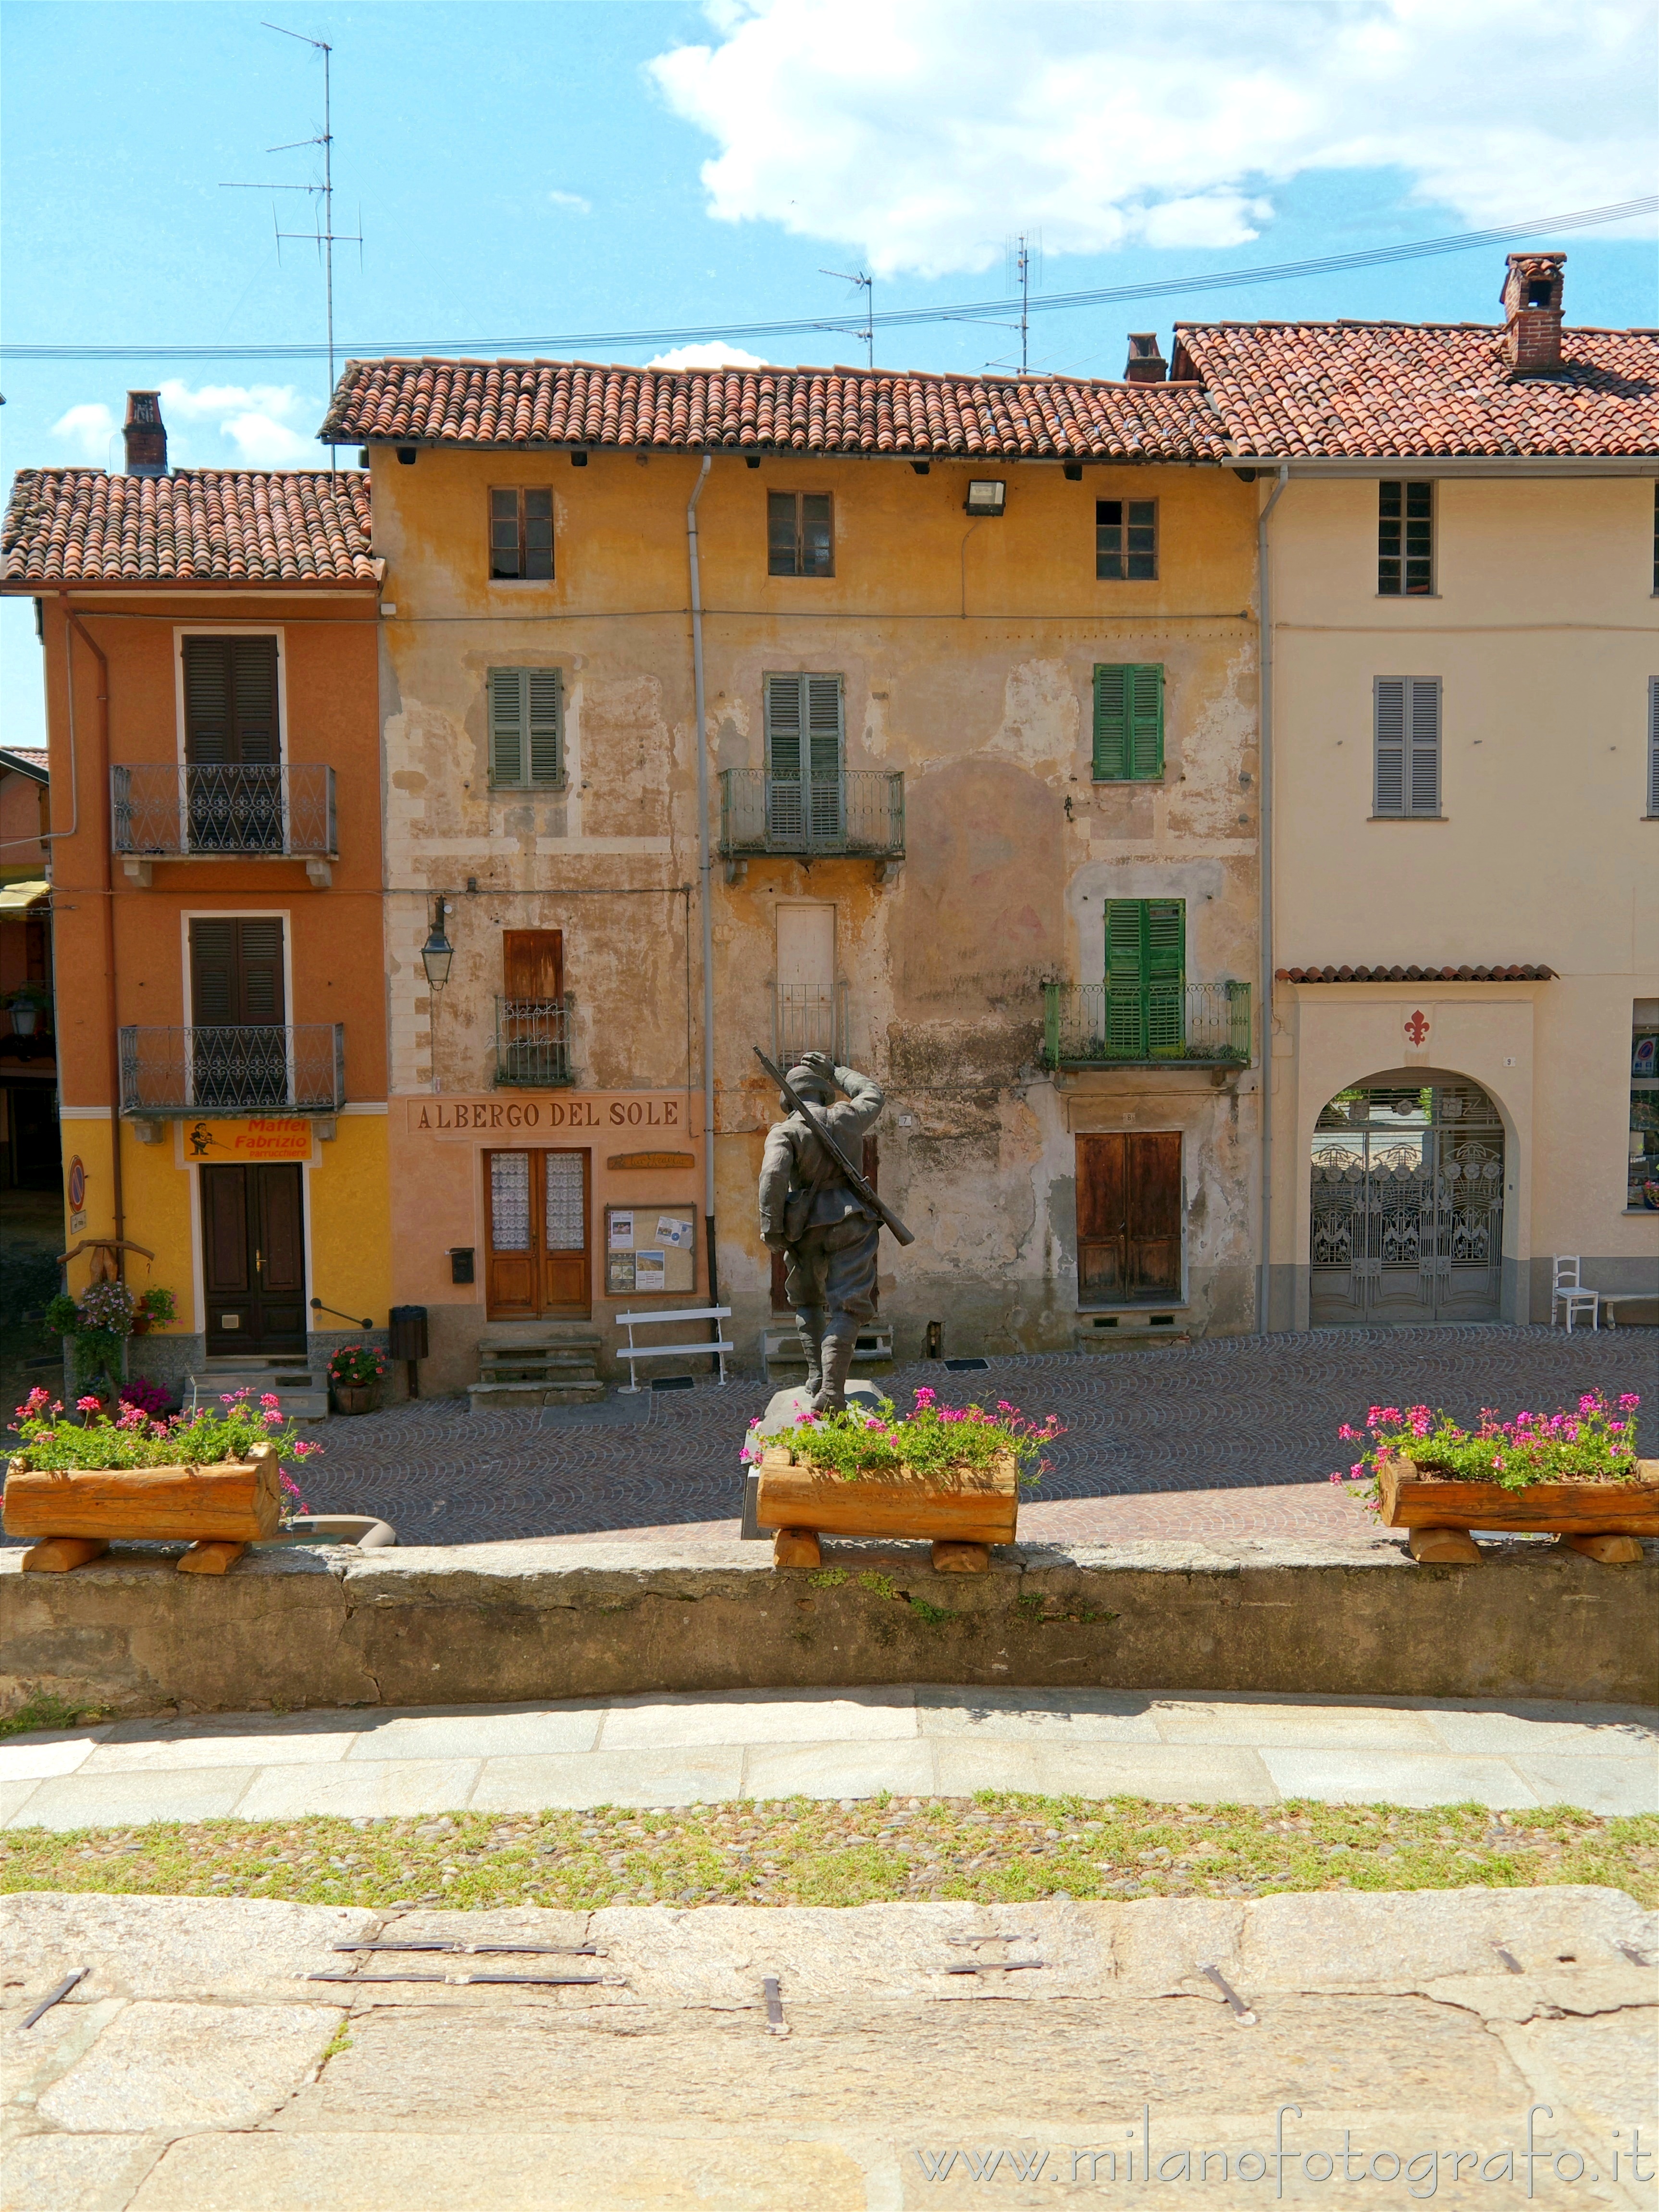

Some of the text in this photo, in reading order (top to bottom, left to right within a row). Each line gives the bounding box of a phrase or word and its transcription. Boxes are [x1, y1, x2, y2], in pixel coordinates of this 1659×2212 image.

[417, 1101, 678, 1128] ALBERGO DEL SOLE
[248, 1118, 307, 1132] Maffei
[235, 1135, 307, 1148] Fabrizio
